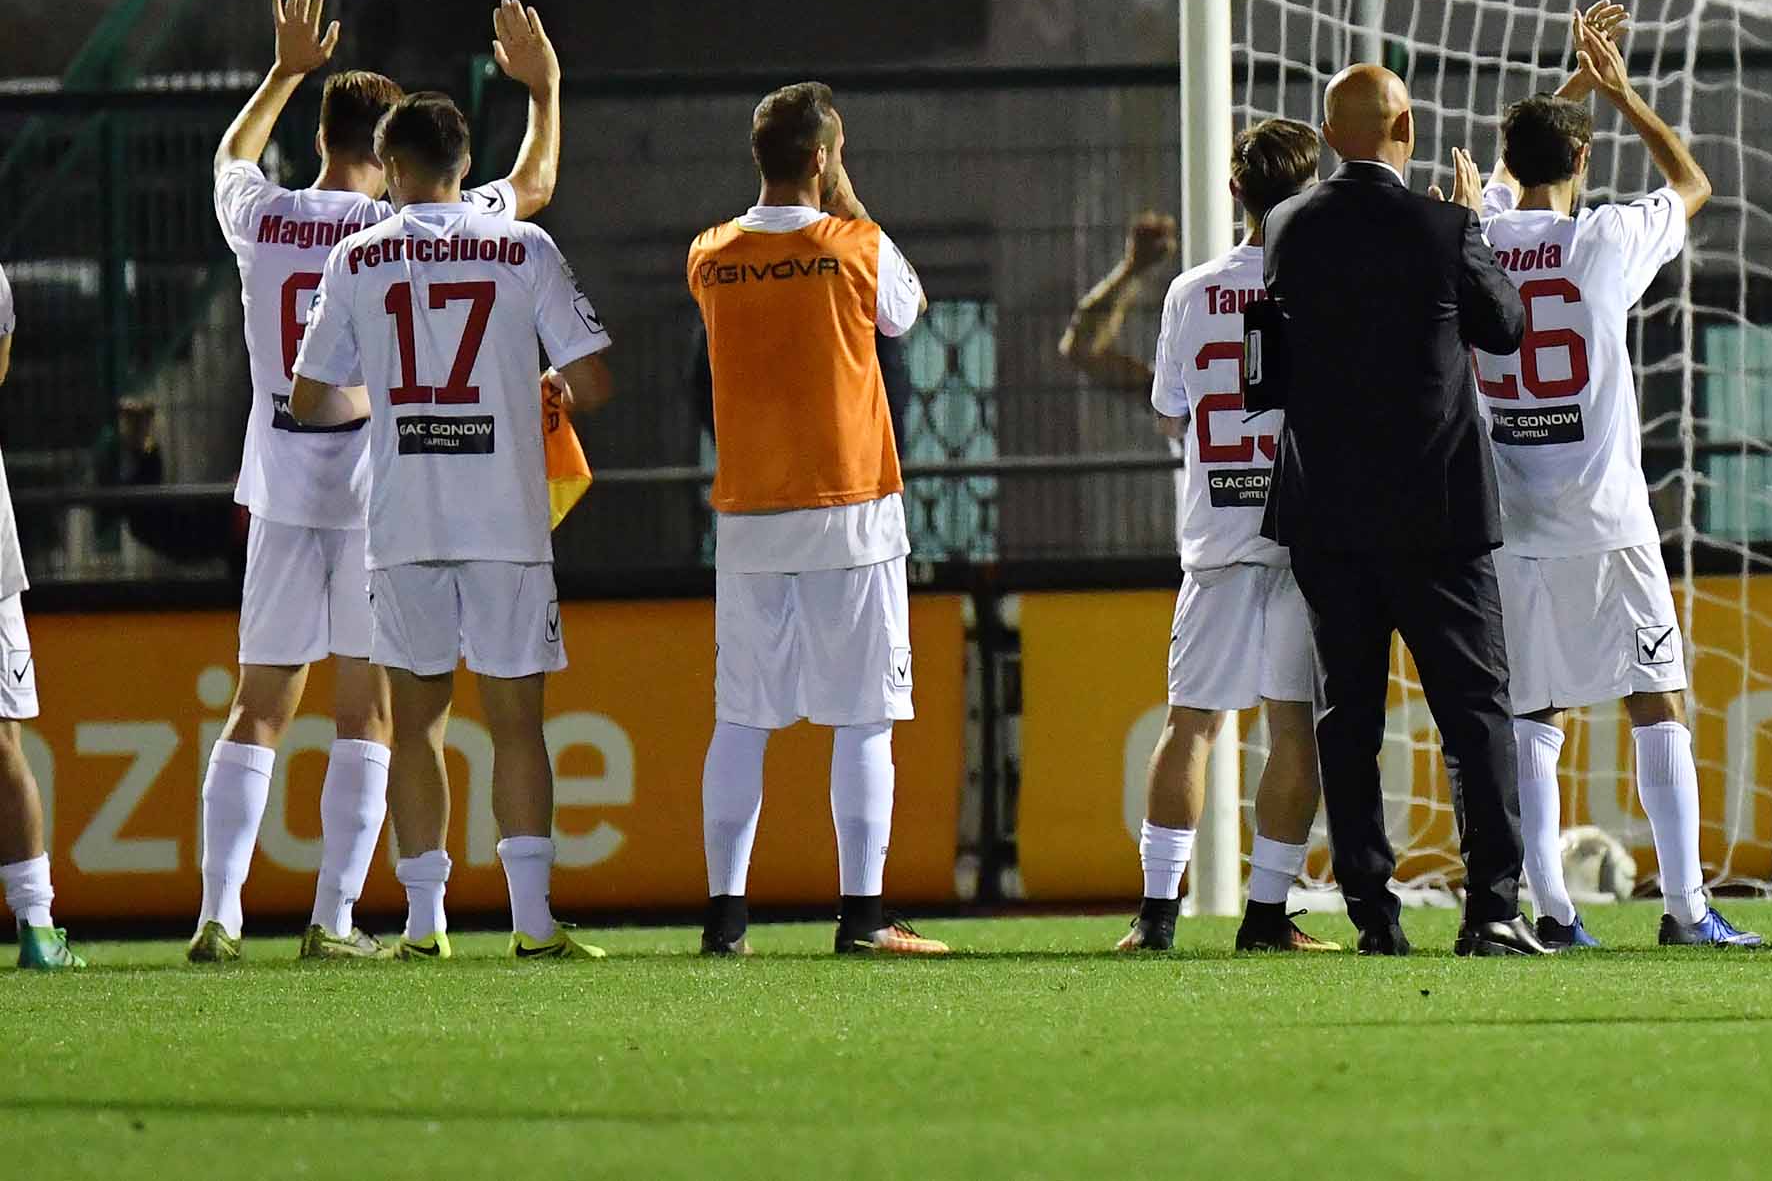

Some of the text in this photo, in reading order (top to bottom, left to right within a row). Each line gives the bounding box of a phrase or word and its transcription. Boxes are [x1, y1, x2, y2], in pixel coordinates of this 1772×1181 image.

[257, 214, 376, 249] Magni
[347, 234, 526, 275] Petricciuolo
[716, 256, 840, 285] GIVOVA
[384, 281, 496, 405] 17
[1195, 341, 1278, 463] 2
[400, 423, 493, 435] GAC GONOW
[1517, 411, 1580, 428] GONOW
[1210, 475, 1244, 488] GAC
